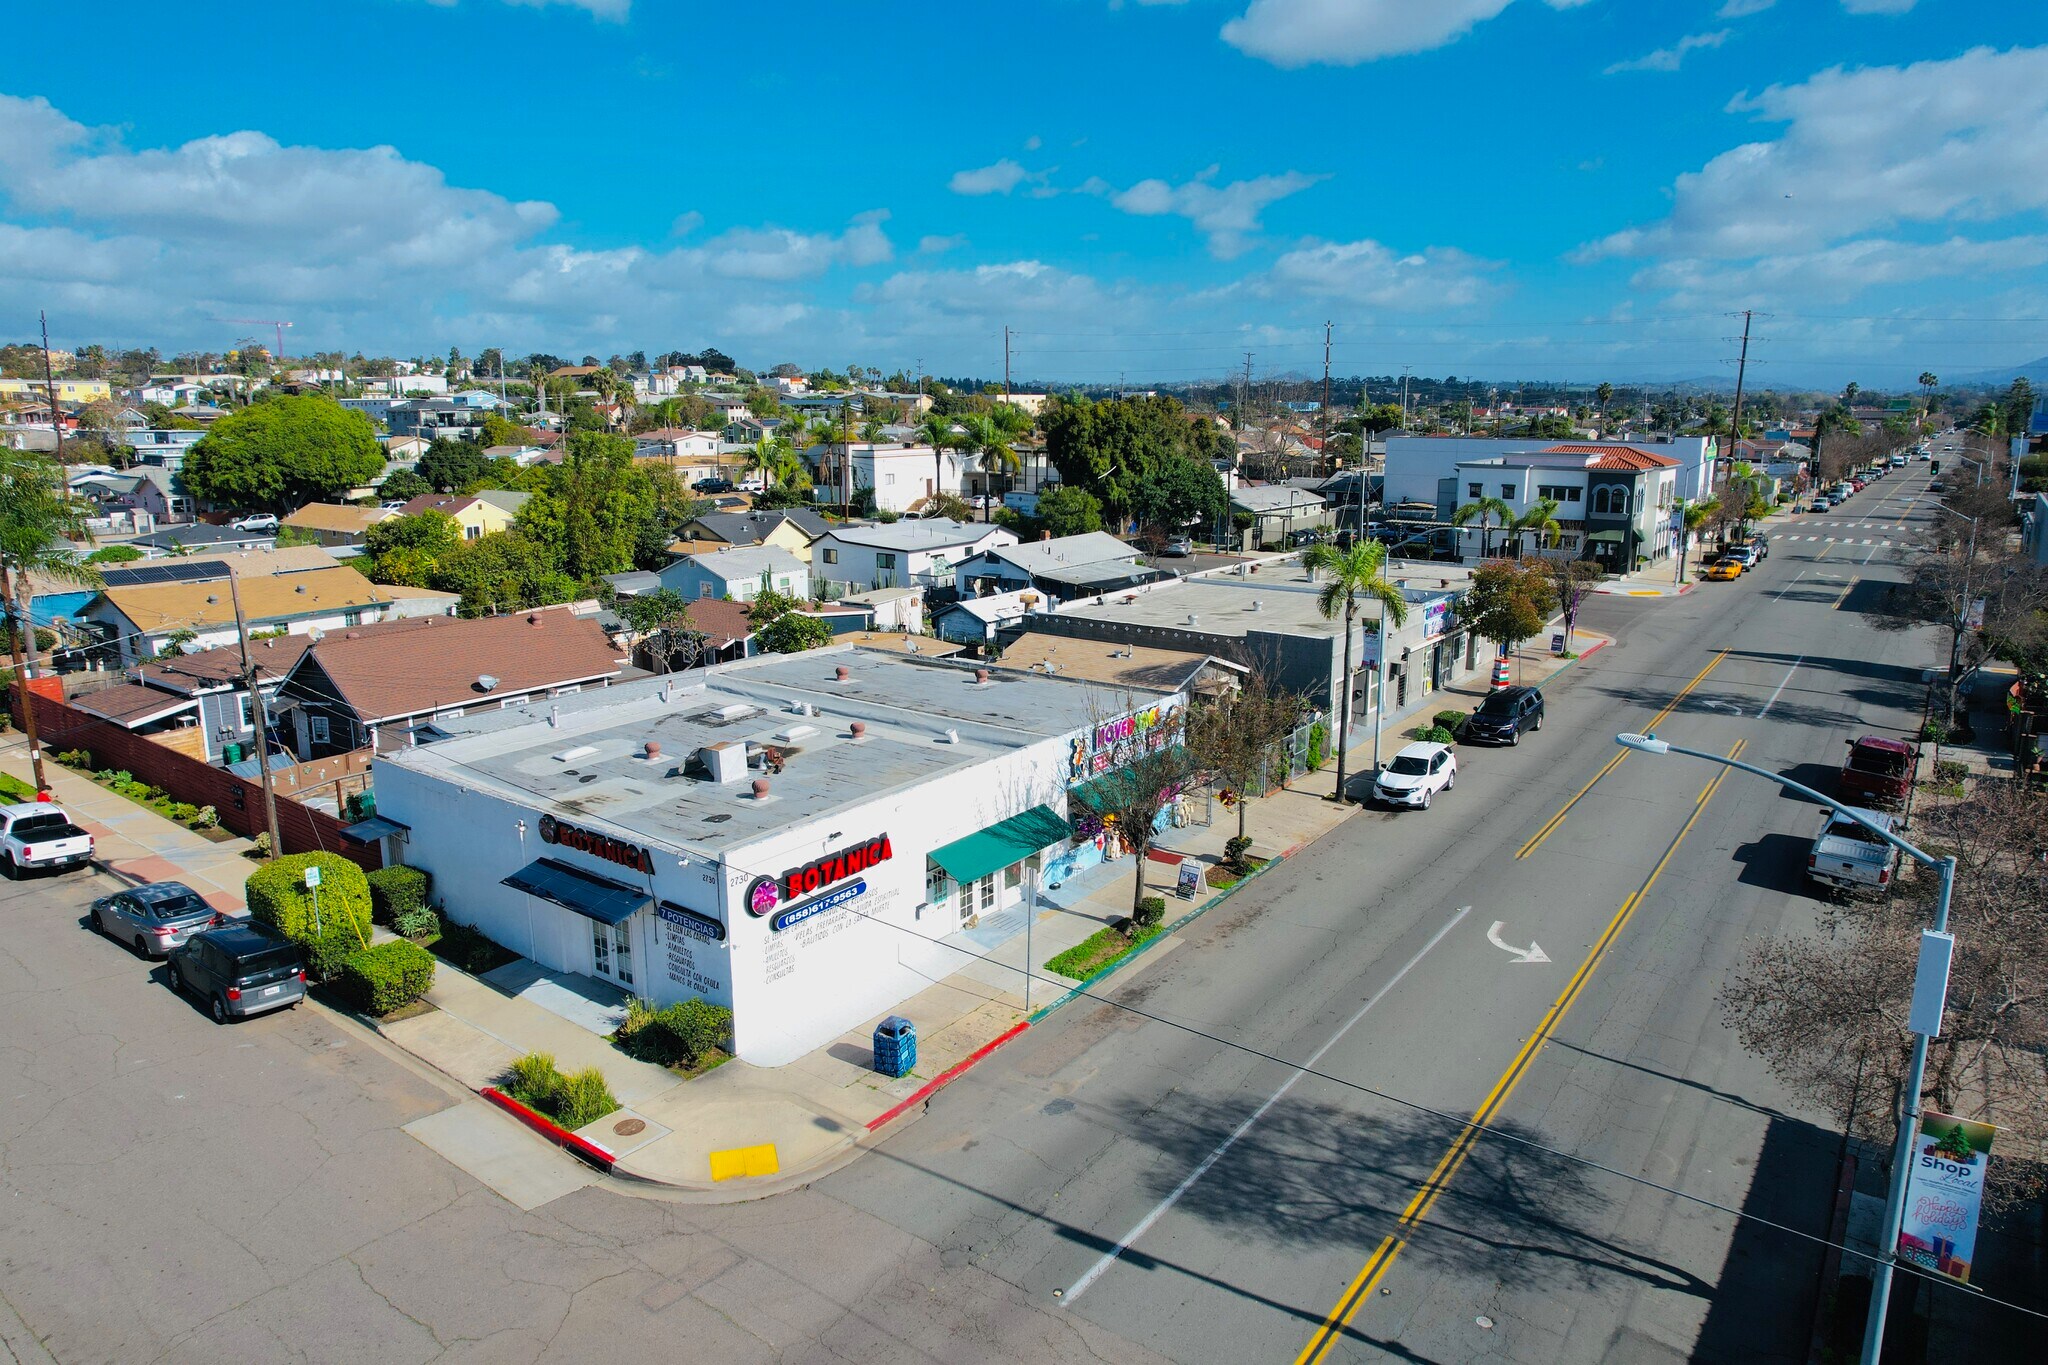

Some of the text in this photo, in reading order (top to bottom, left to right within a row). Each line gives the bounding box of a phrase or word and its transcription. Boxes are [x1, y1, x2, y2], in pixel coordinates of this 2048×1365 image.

[558, 822, 650, 874] BOTANICA
[787, 836, 892, 899] BOTANICA
[702, 874, 716, 884] 2730
[730, 873, 748, 887] 2730
[784, 887, 858, 925] (858)617-9563
[661, 909, 715, 937] 7 POTENCIAS
[832, 922, 844, 934] CON
[667, 932, 685, 945] LIMPIAS
[693, 972, 702, 983] CON
[1921, 1156, 1971, 1177] Shop
[1939, 1174, 1978, 1188] Local
[1916, 1195, 1968, 1217] Happy
[1912, 1204, 1967, 1231] holidays
